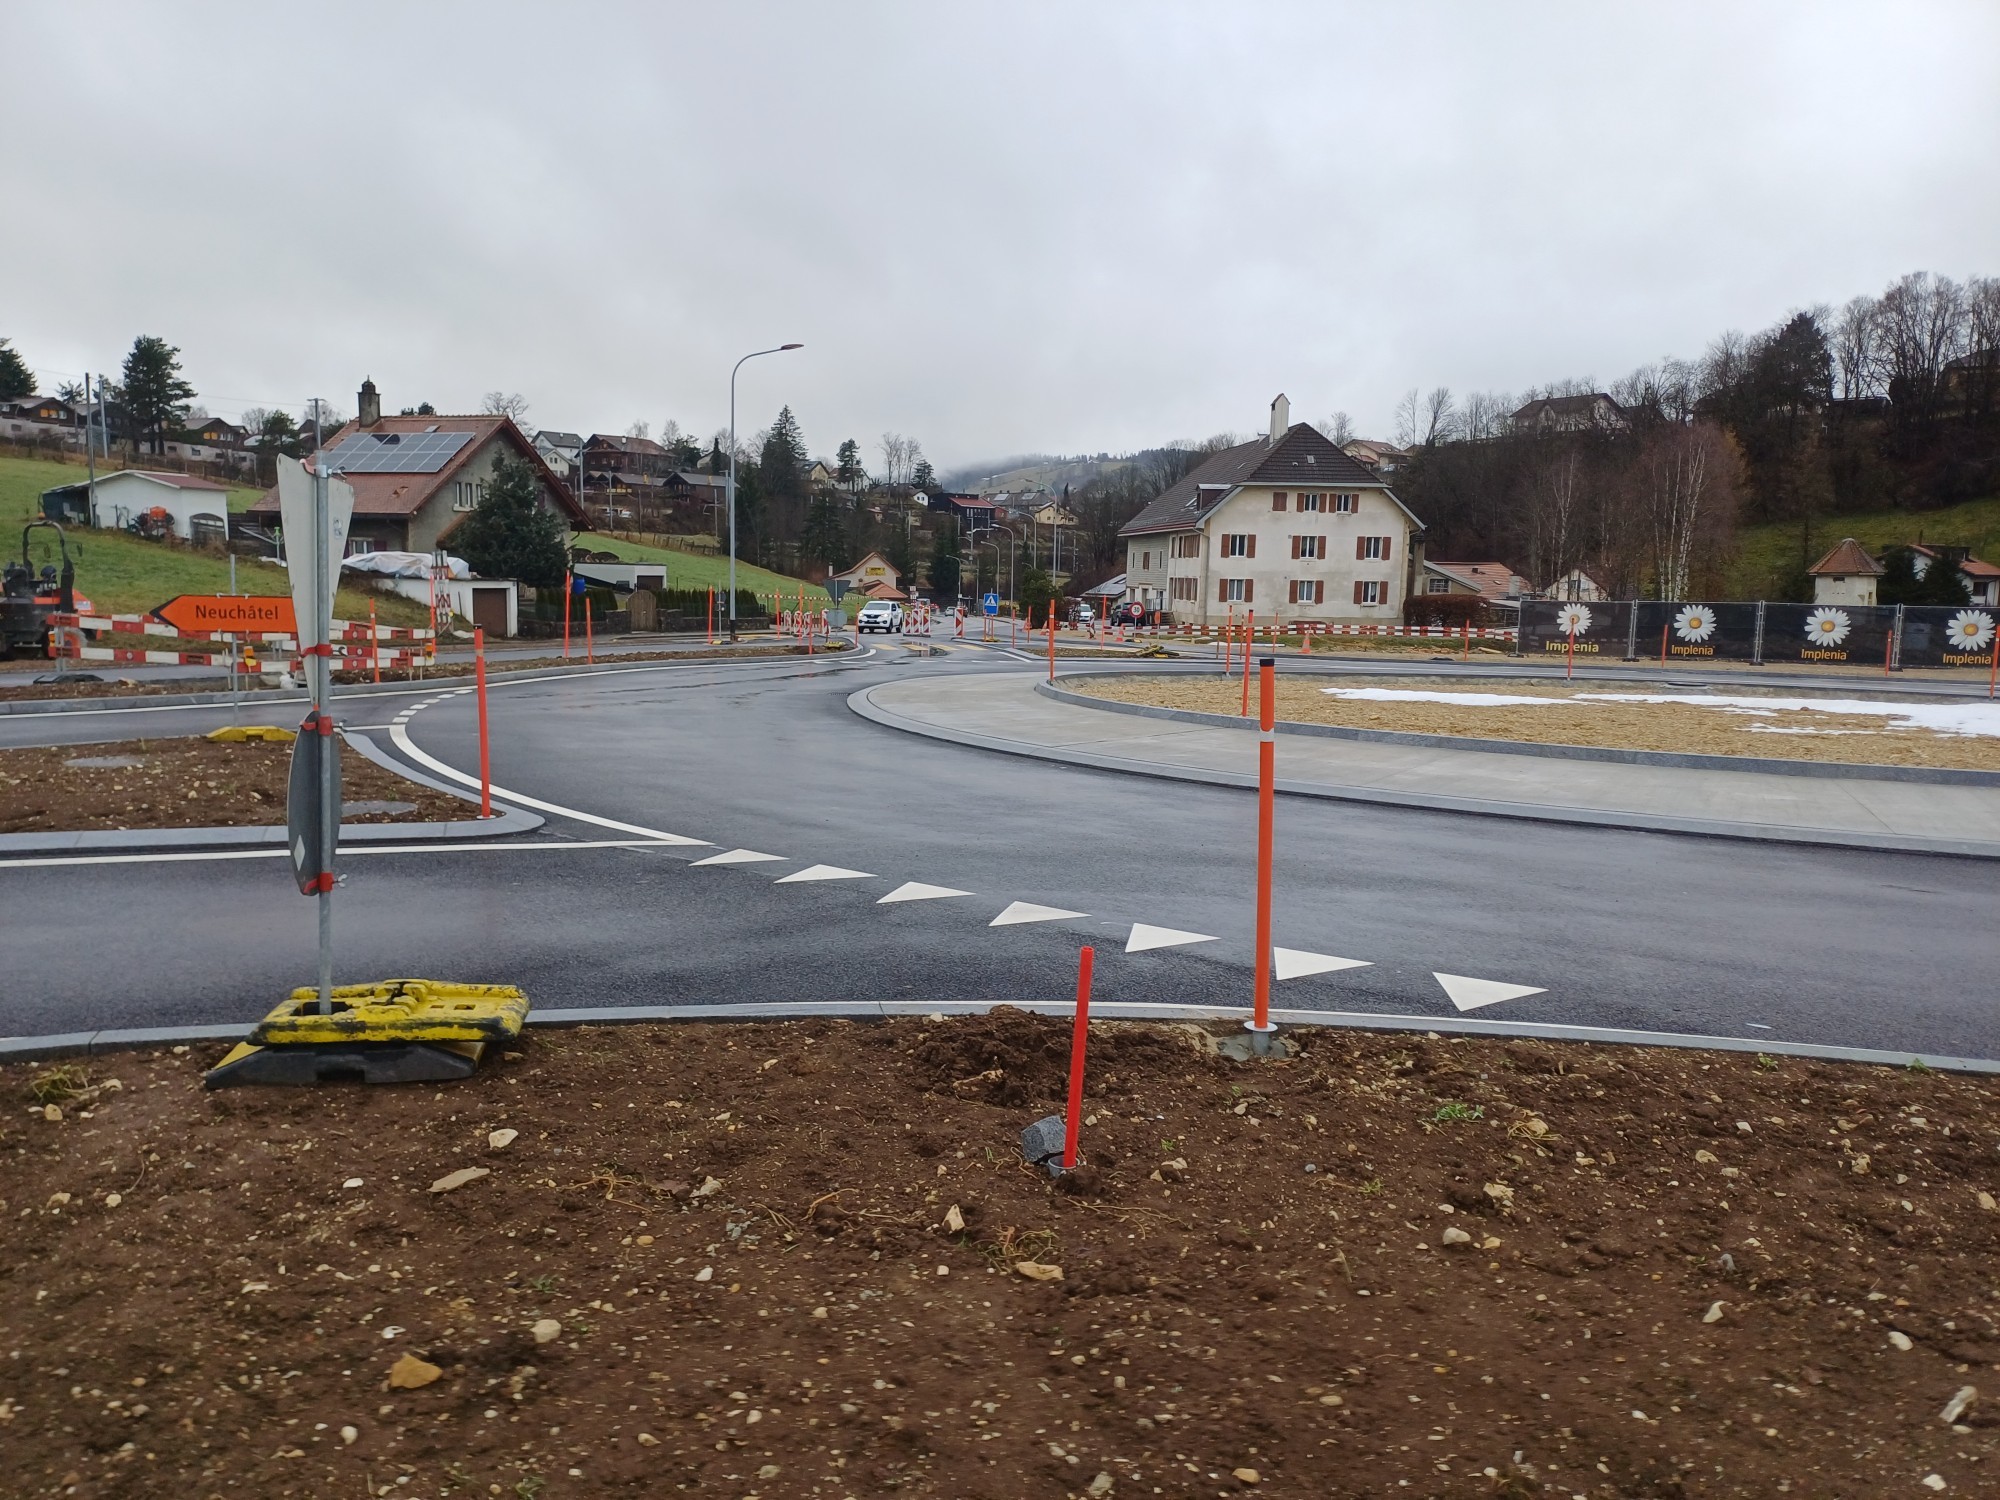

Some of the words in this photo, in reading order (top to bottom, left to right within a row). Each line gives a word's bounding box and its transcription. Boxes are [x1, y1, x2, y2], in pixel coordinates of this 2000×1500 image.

[195, 605, 279, 620] Neuchâtel
[1545, 640, 1600, 654] Impenia
[1671, 644, 1714, 656] Implenia
[1801, 648, 1847, 661] Implenia
[1942, 653, 1992, 666] Implenia
